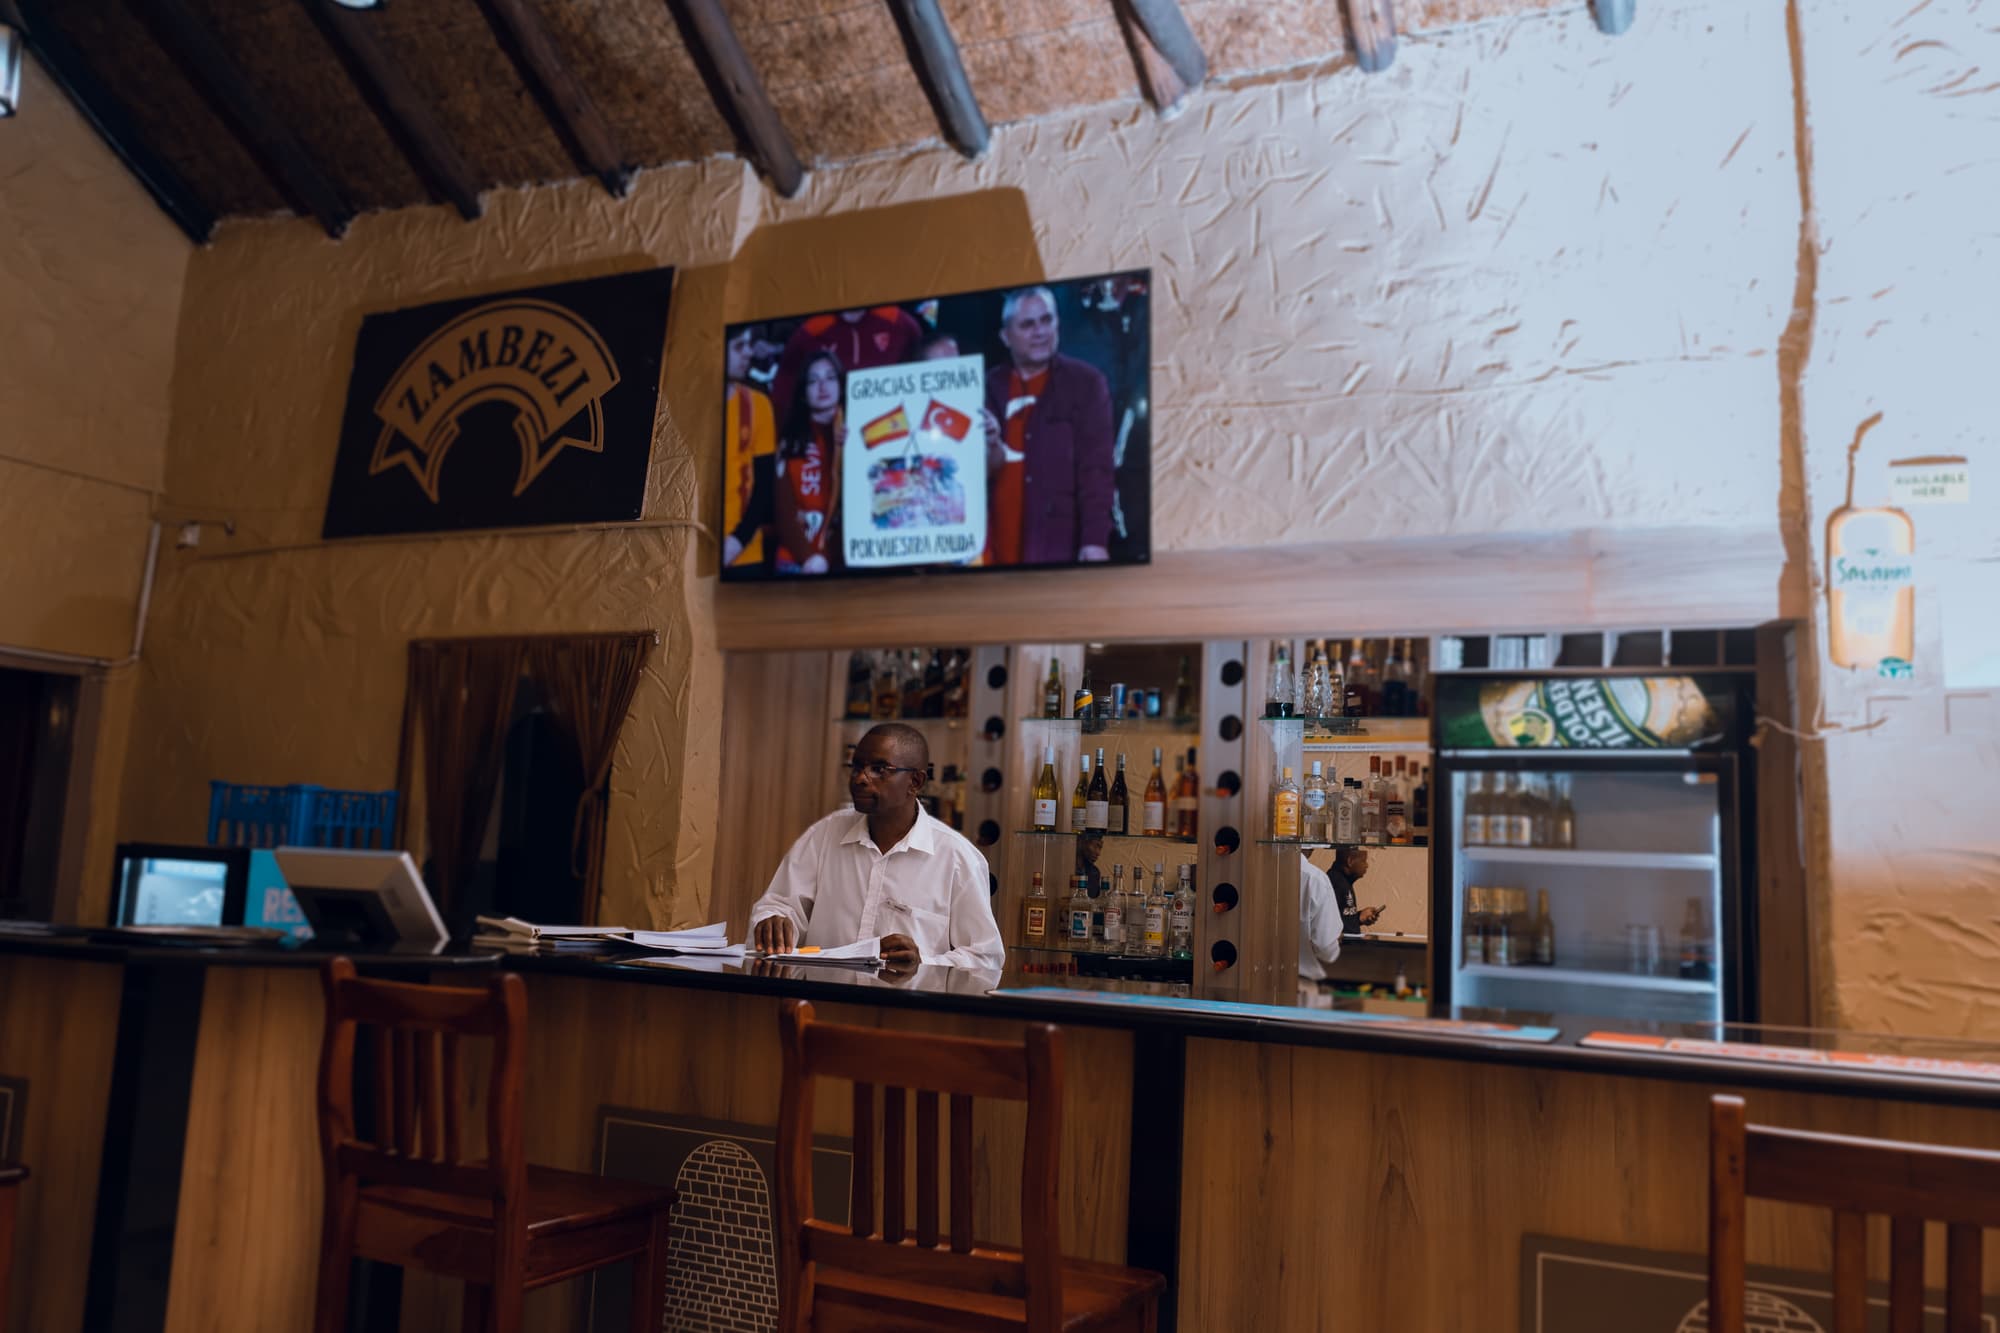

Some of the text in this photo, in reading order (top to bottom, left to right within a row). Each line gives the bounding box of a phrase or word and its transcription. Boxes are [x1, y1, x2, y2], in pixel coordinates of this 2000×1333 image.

[398, 325, 591, 425] ZAMBEZI
[851, 373, 916, 400] GRACIAS
[1895, 473, 1966, 485] AVAILABLE
[1911, 486, 1946, 497] HERE
[850, 538, 875, 560] POR
